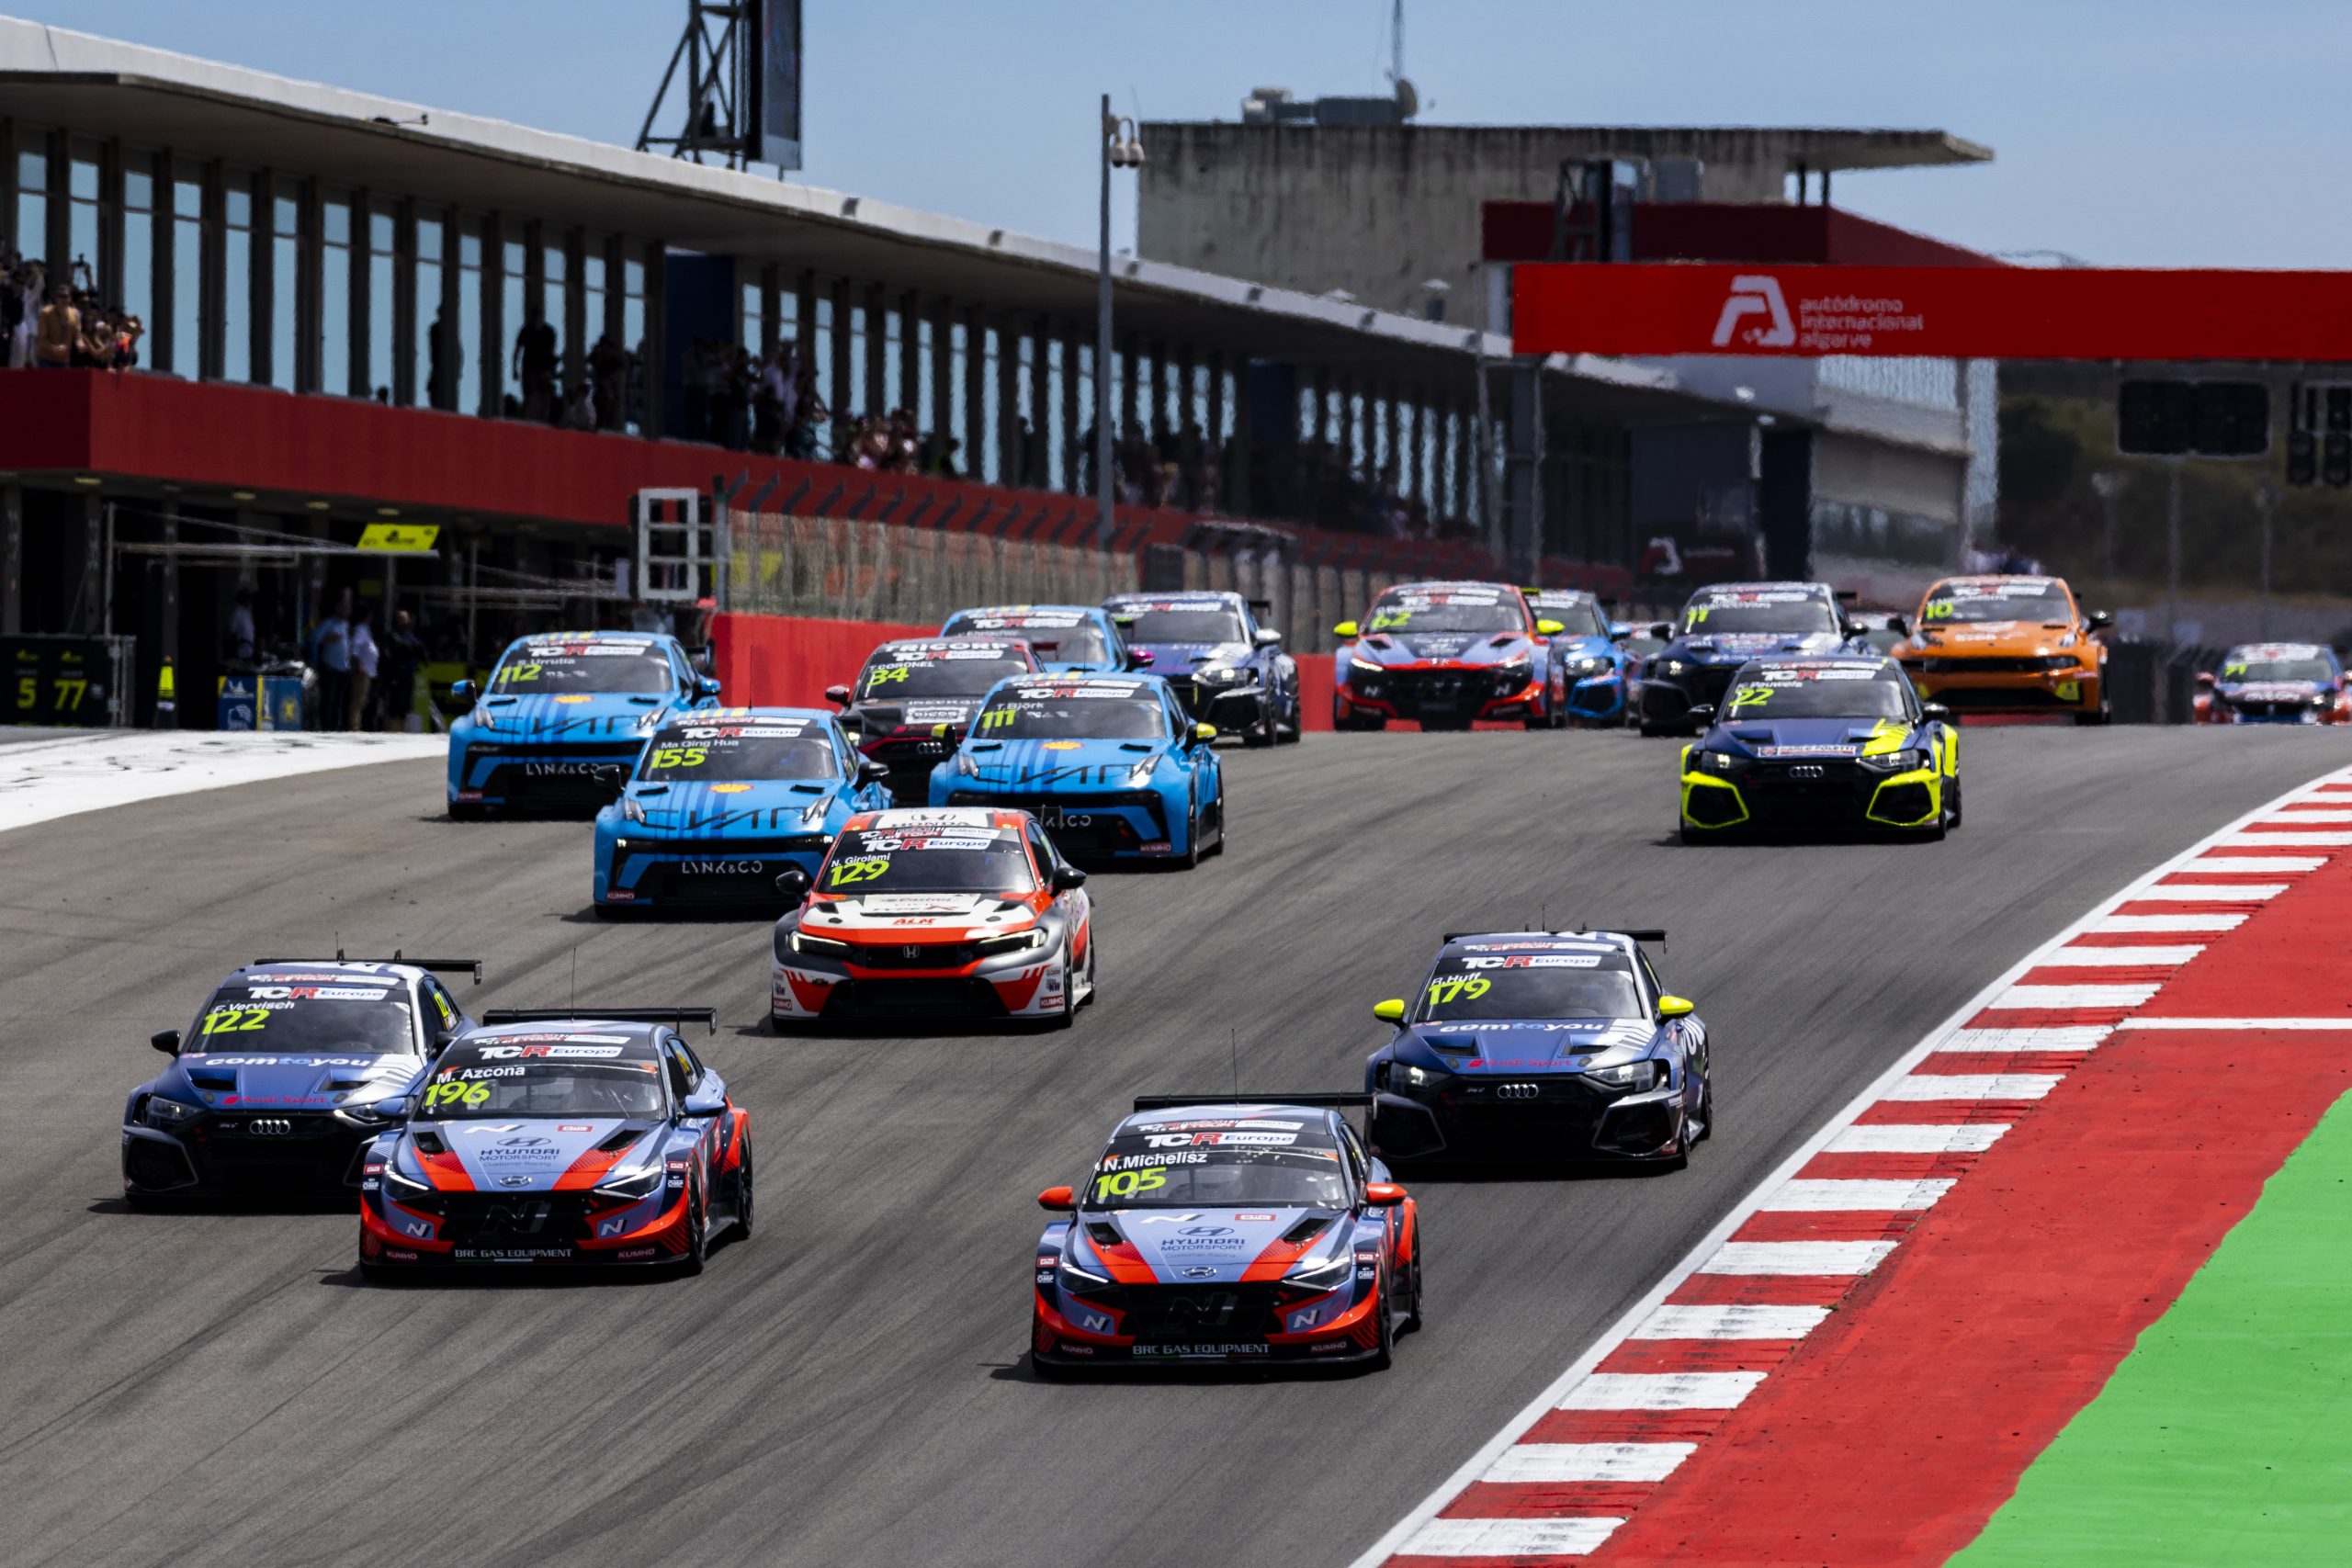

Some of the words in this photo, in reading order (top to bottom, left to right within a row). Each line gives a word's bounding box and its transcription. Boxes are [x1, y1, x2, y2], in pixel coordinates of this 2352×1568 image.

[1799, 296, 1904, 314] autódromo
[1800, 314, 1924, 331] internacional
[1800, 331, 1873, 350] algarve
[886, 643, 1010, 653] TRICORP
[498, 664, 542, 684] 112
[866, 667, 910, 687] 34
[17, 678, 38, 709] 5
[54, 679, 87, 711] 77
[1017, 688, 1077, 699] TCR
[1729, 688, 1775, 706] 22
[981, 708, 1018, 729] 111
[681, 727, 744, 739] TCR
[650, 748, 709, 770] 155
[862, 839, 928, 852] TCR
[844, 852, 891, 865] Girolami
[831, 861, 890, 886] 129
[1462, 956, 1533, 969] TCR
[248, 987, 319, 999] TCR
[320, 989, 383, 998] Europe
[1428, 979, 1492, 1006] 179
[202, 1010, 271, 1035] 122
[1440, 1022, 1604, 1032] comtoyou
[478, 1045, 551, 1059] TCR
[552, 1047, 618, 1055] Europe
[206, 1057, 371, 1066] comtoyou
[1528, 1059, 1572, 1068] Sport
[436, 1073, 457, 1084] M.
[460, 1066, 526, 1080] Azcona
[282, 1096, 326, 1104] Sport
[424, 1081, 490, 1107] 196
[1144, 1133, 1223, 1148] TCR
[1224, 1134, 1293, 1143] Europe
[1103, 1153, 1208, 1172] N.Michelisz
[1096, 1167, 1167, 1199] 105
[455, 1249, 477, 1258] BRC
[481, 1249, 504, 1258] GAS
[507, 1249, 572, 1258] EQUIPMENT
[617, 1248, 656, 1258] KUMHO
[1133, 1345, 1159, 1354] BRC
[1163, 1344, 1192, 1354] GAS
[1194, 1344, 1270, 1354] EQUIPMENT
